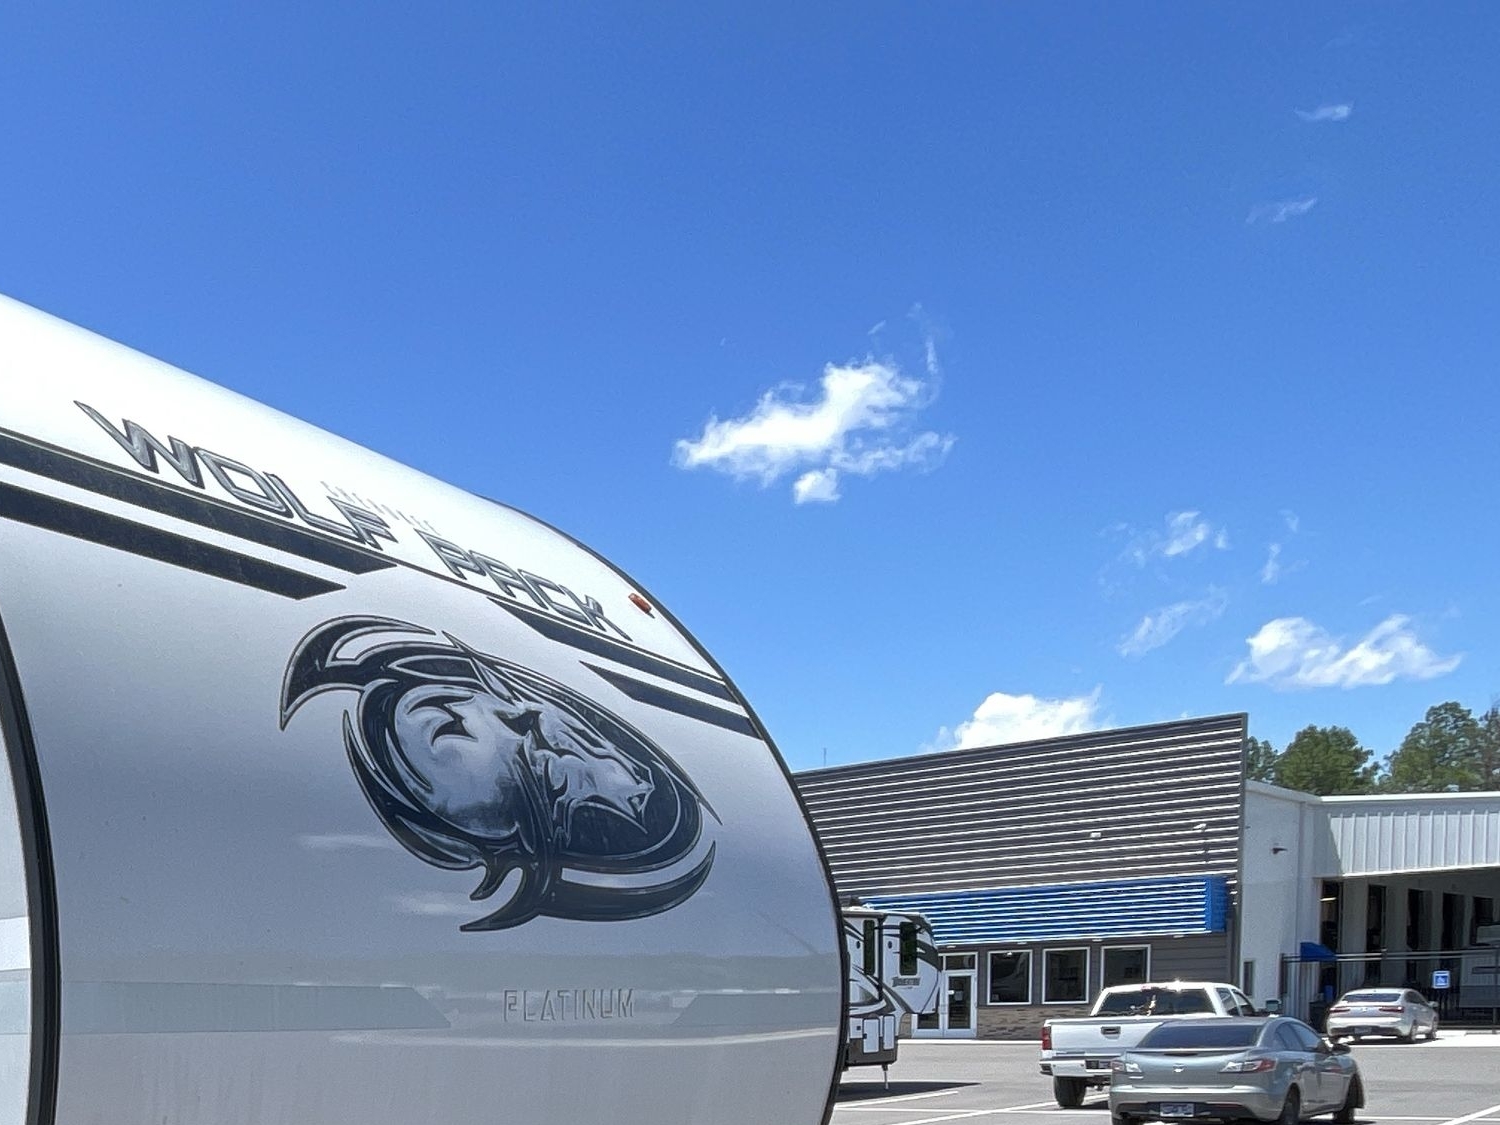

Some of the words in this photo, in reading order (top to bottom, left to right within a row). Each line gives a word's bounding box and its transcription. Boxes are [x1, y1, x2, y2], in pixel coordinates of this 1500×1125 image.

[73, 399, 399, 552] WOLF
[413, 527, 634, 642] PACK
[503, 987, 635, 1023] PLATINUM
